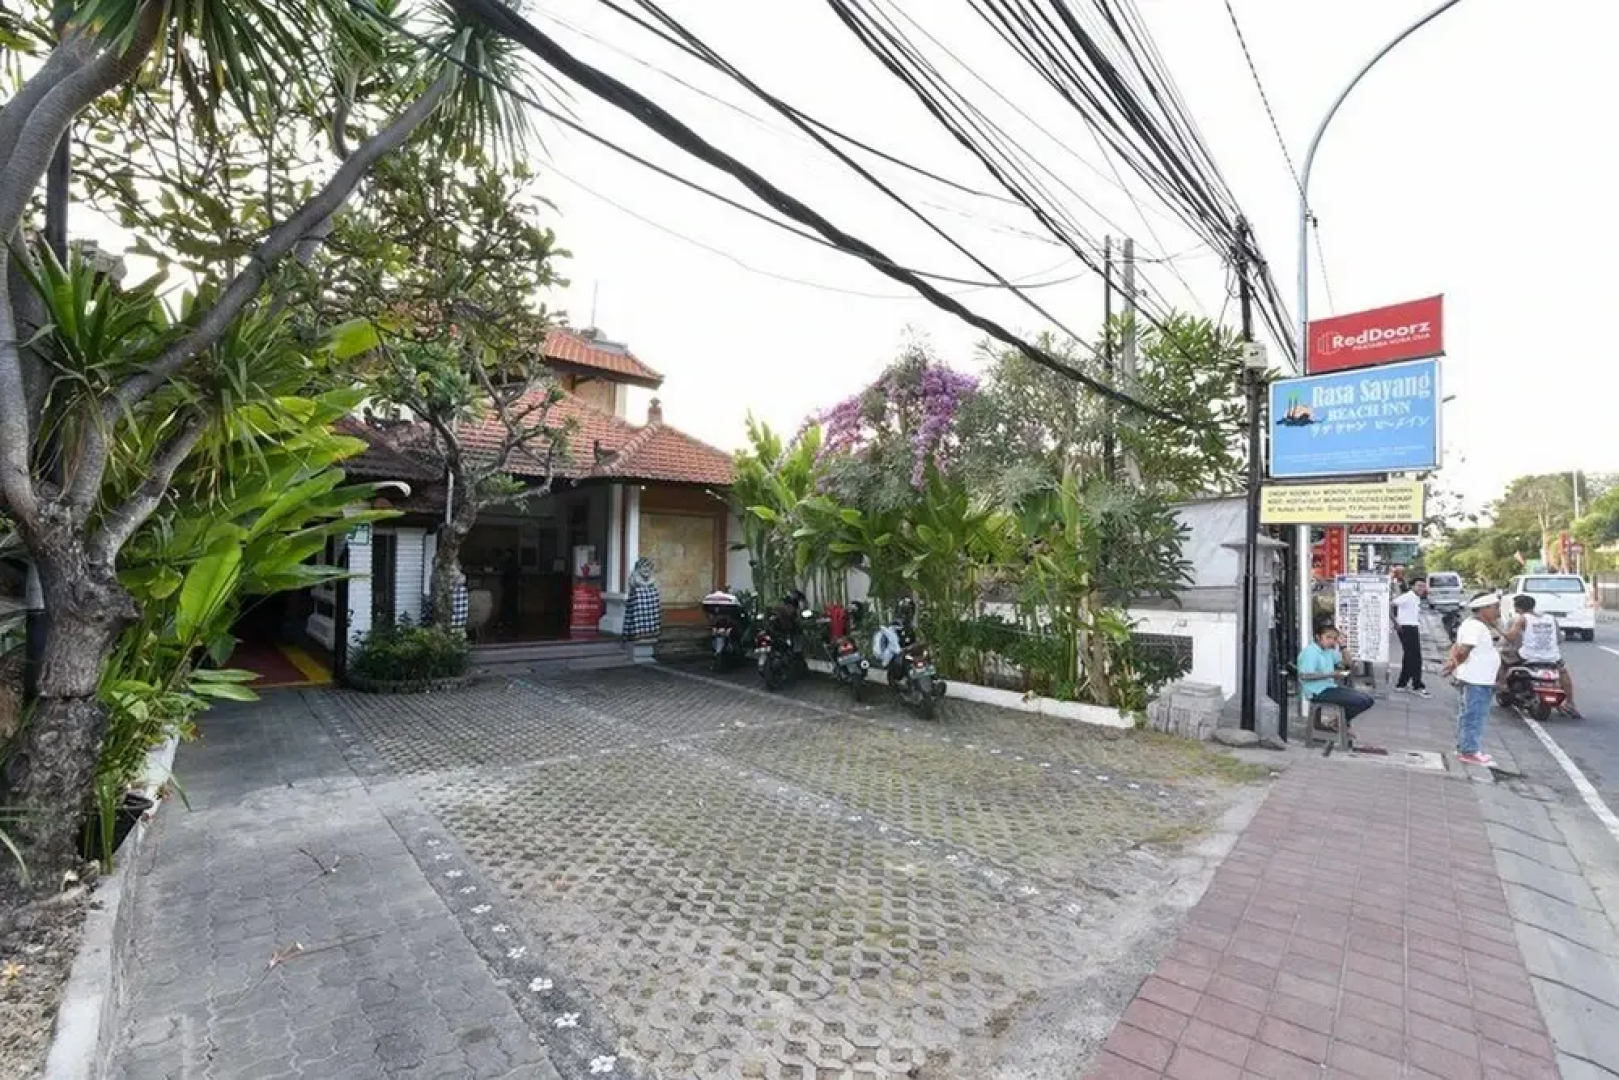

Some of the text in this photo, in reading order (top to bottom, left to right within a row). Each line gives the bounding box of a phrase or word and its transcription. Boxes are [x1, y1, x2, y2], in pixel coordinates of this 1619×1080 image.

[1333, 322, 1431, 348] RedDoorz
[1312, 374, 1431, 407] Rasa Sayang
[1328, 400, 1411, 421] BEACH INN
[1351, 523, 1414, 534] TATTOO
